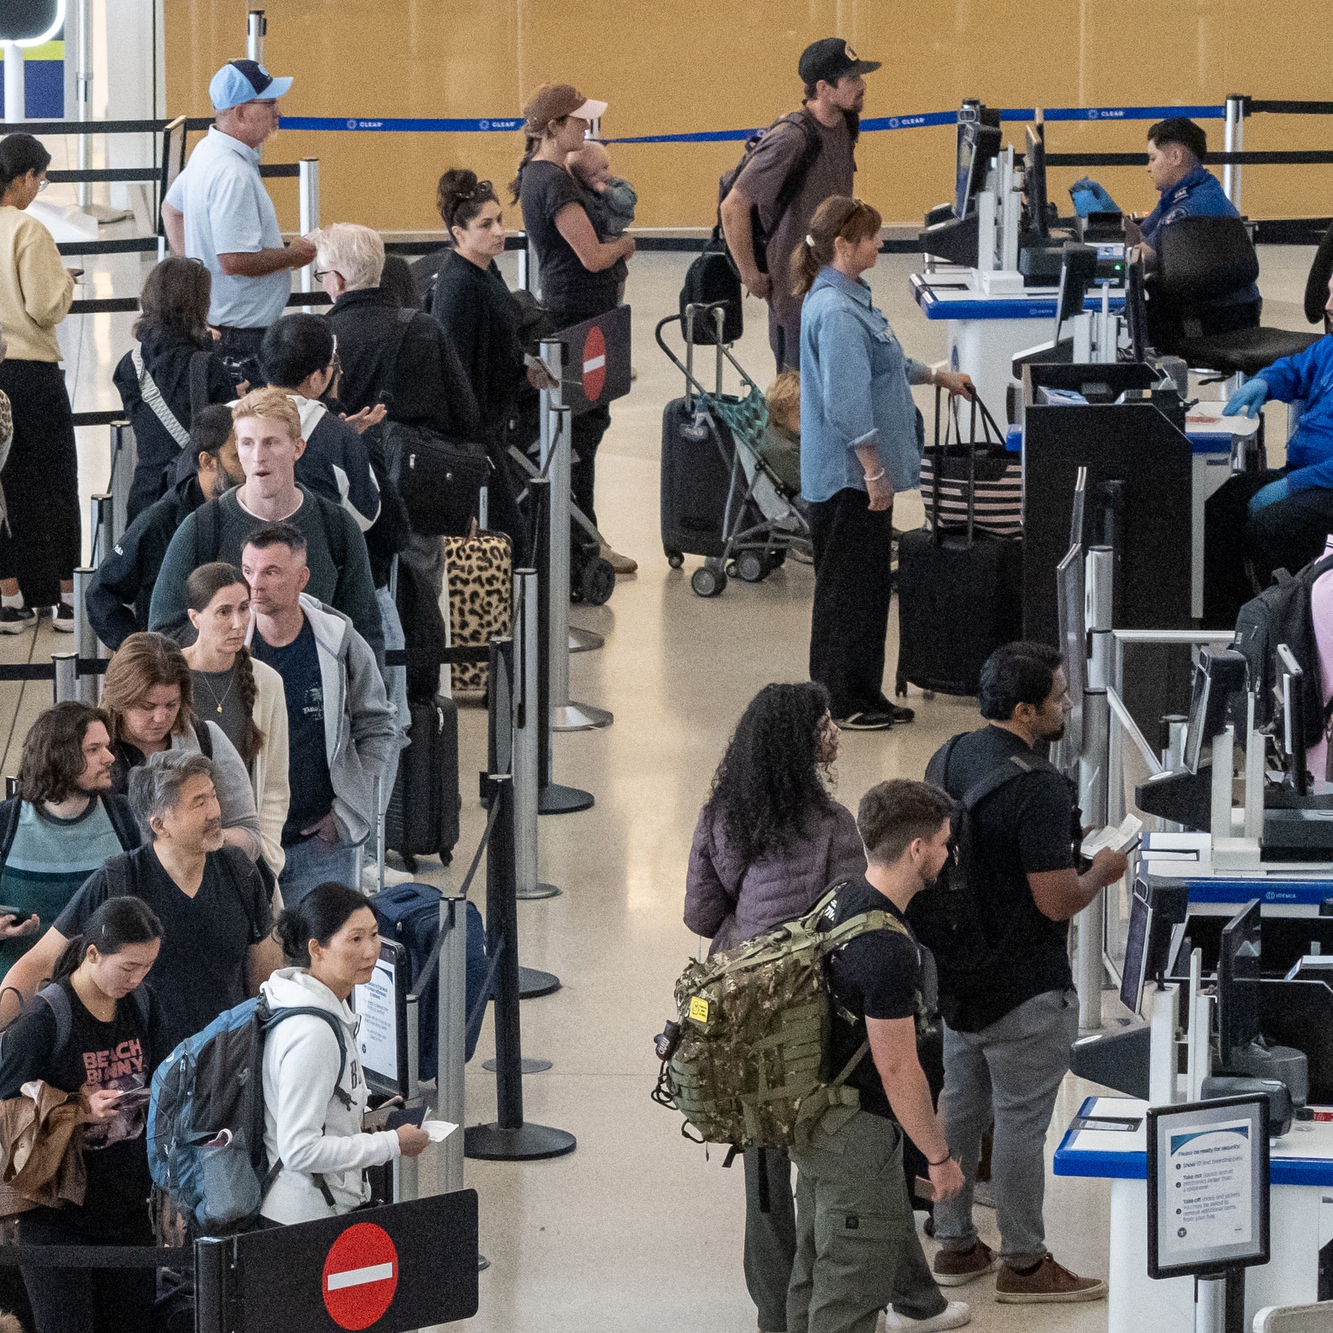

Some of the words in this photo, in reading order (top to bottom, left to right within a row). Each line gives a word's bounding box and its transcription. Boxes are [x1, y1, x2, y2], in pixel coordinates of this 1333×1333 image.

[901, 117, 925, 125] CLEAR
[82, 1038, 143, 1070] BEACH
[86, 1055, 143, 1085] BUNNY
